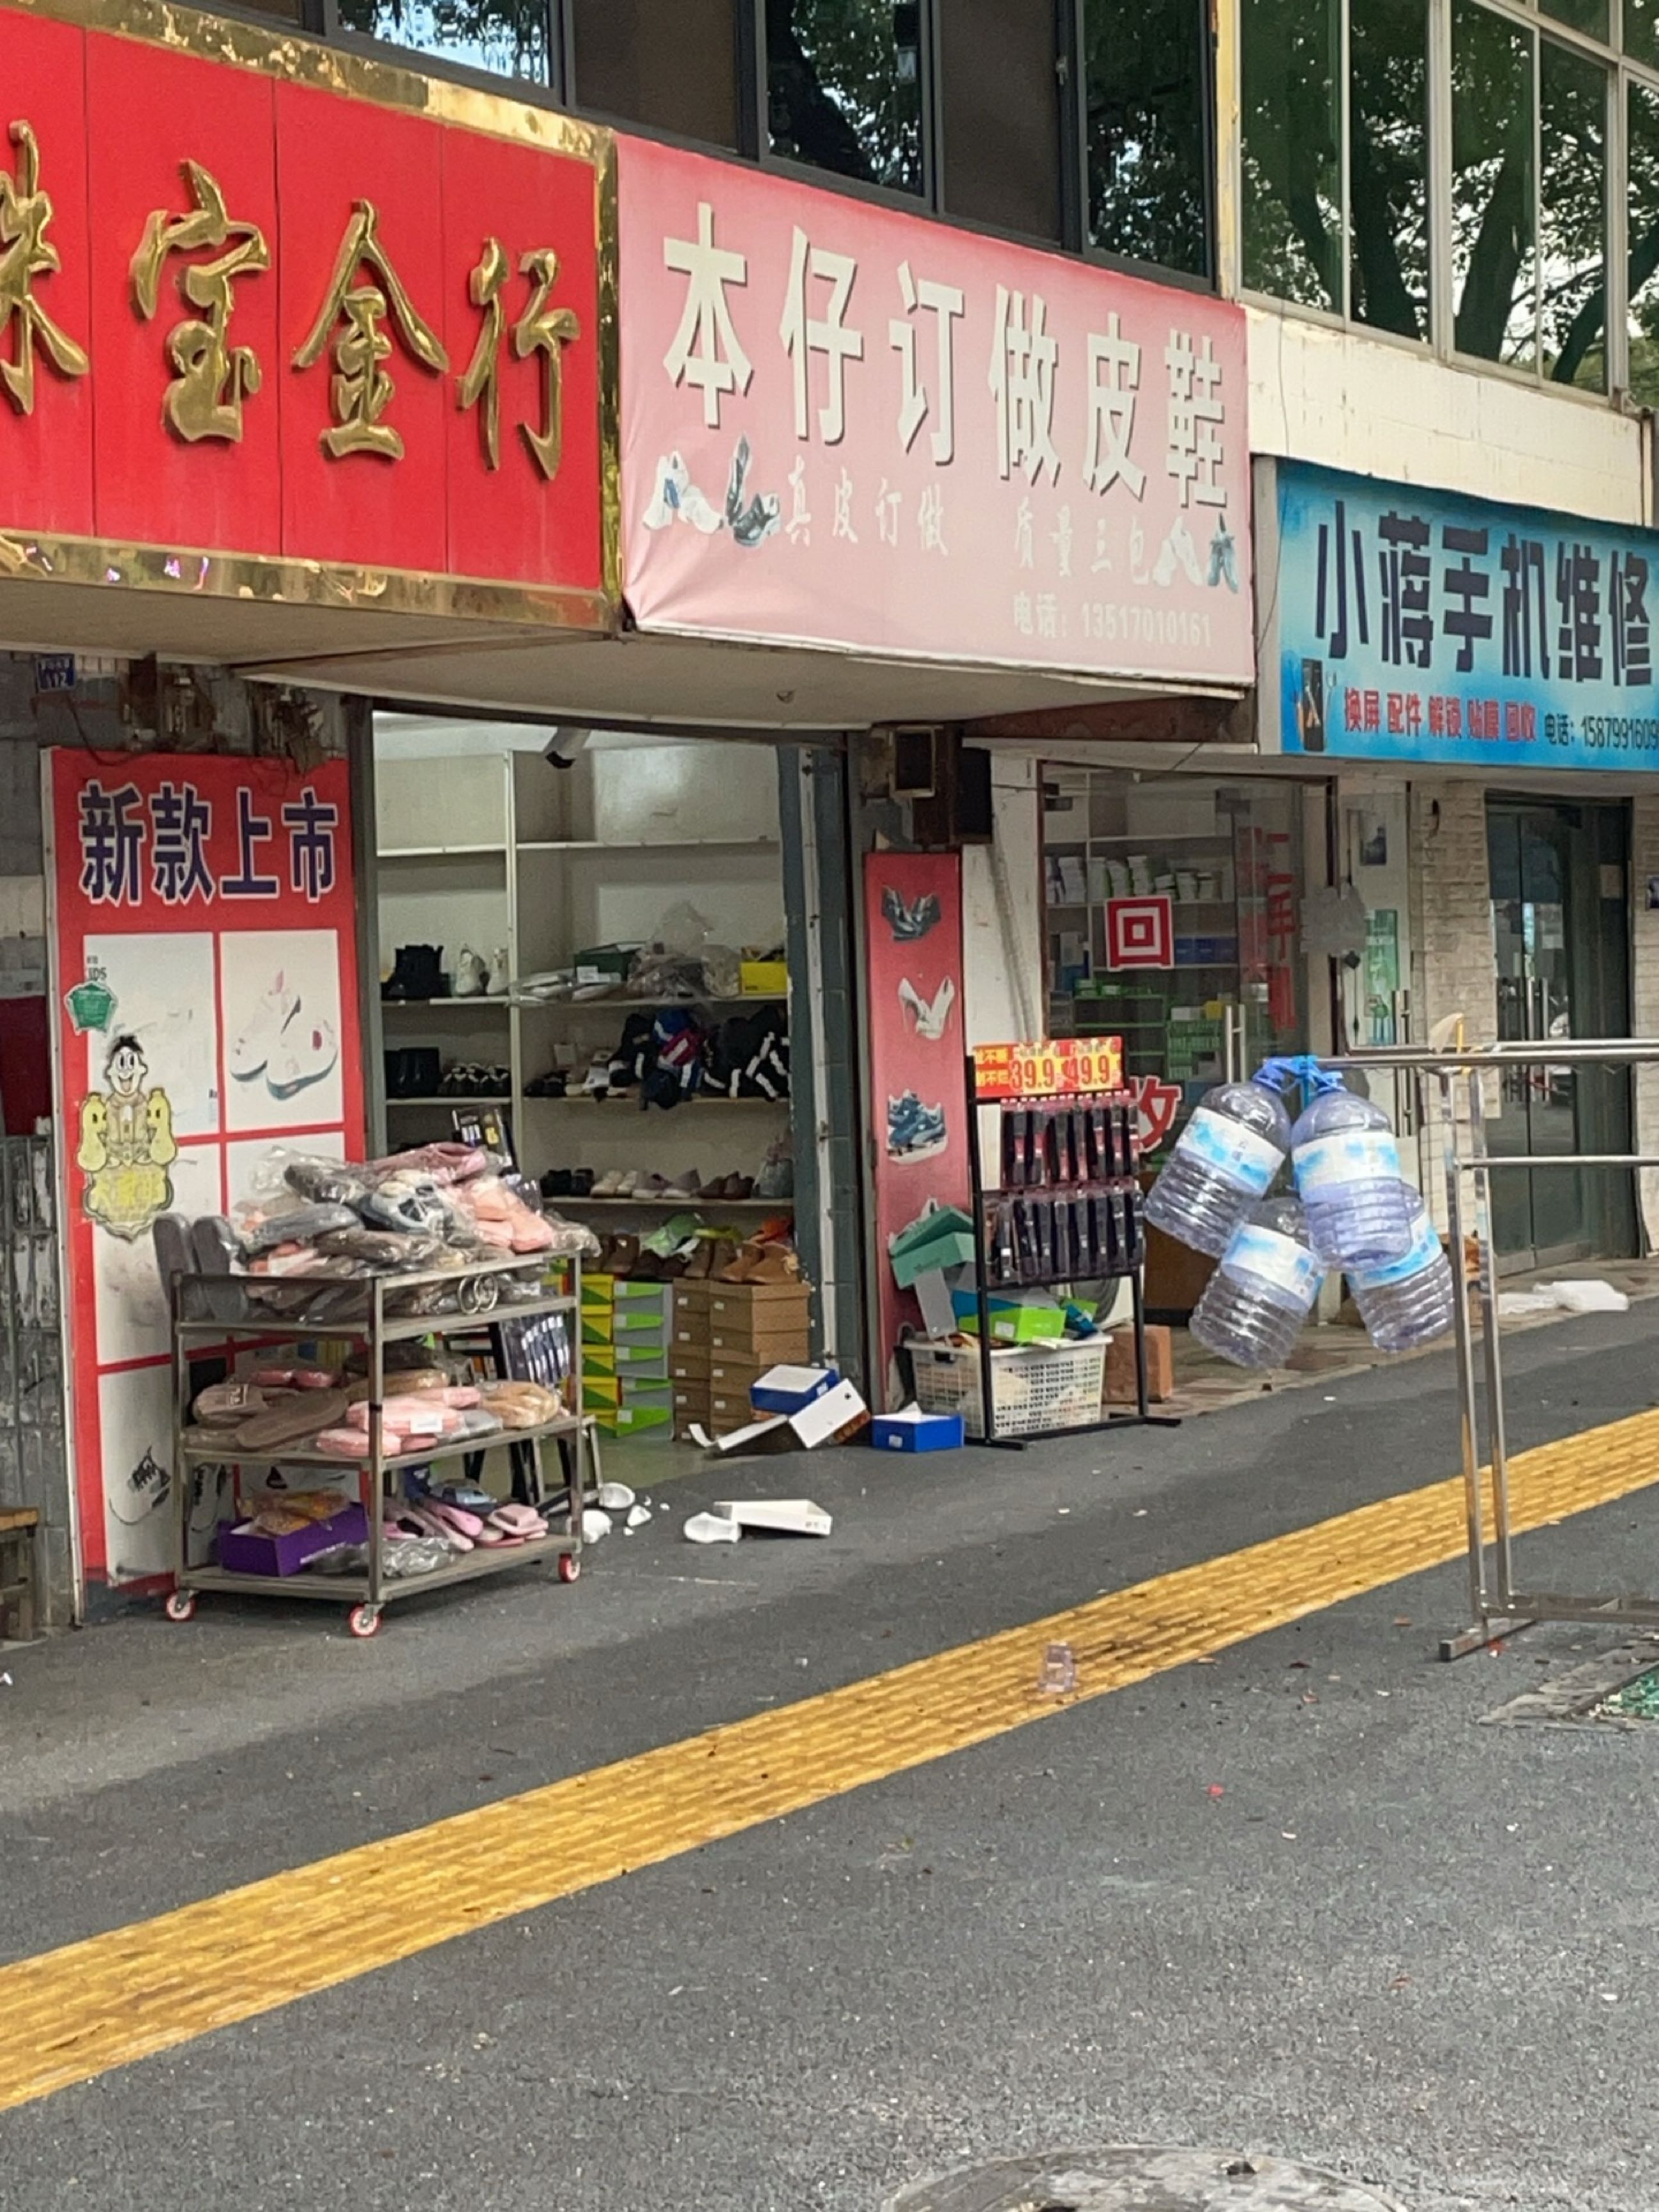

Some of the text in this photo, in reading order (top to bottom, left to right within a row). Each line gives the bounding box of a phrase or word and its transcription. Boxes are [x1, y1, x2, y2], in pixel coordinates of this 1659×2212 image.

[664, 202, 1227, 508] 本仔订做皮鞋
[785, 454, 949, 556] 真皮订做
[1015, 497, 1150, 585] 质量三包
[1082, 602, 1211, 646] 13517010161
[79, 780, 338, 907] 新款上市
